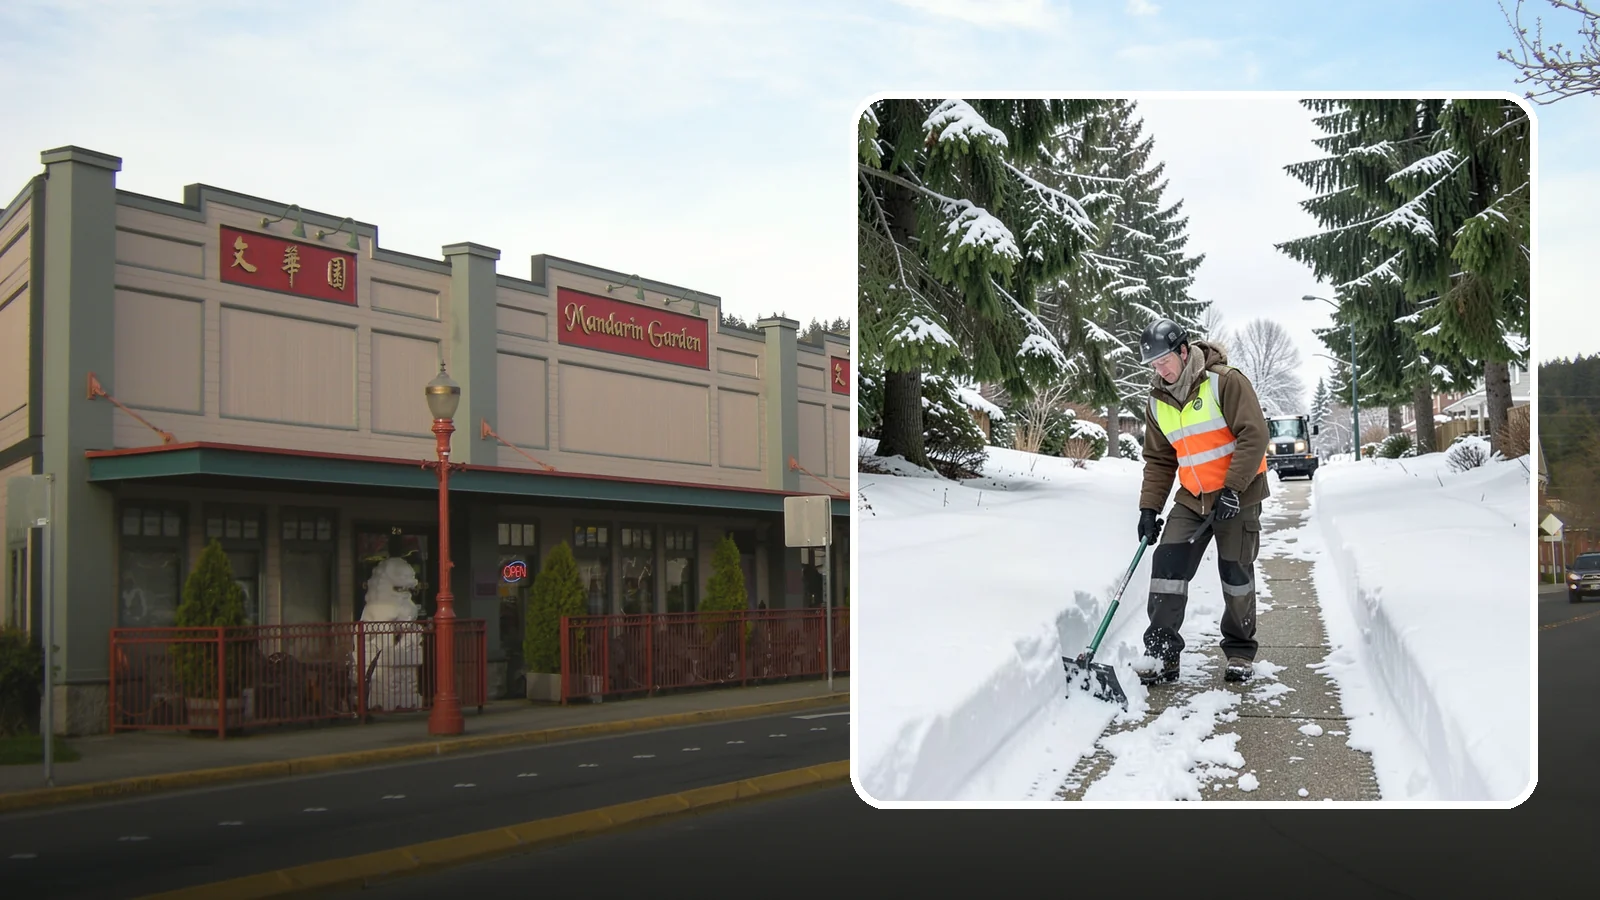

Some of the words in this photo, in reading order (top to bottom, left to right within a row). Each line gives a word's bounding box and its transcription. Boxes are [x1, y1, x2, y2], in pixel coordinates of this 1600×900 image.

[231, 236, 346, 291] 文華園
[564, 302, 644, 341] Mandarin
[647, 320, 702, 352] Garden
[503, 565, 527, 578] OPEN
